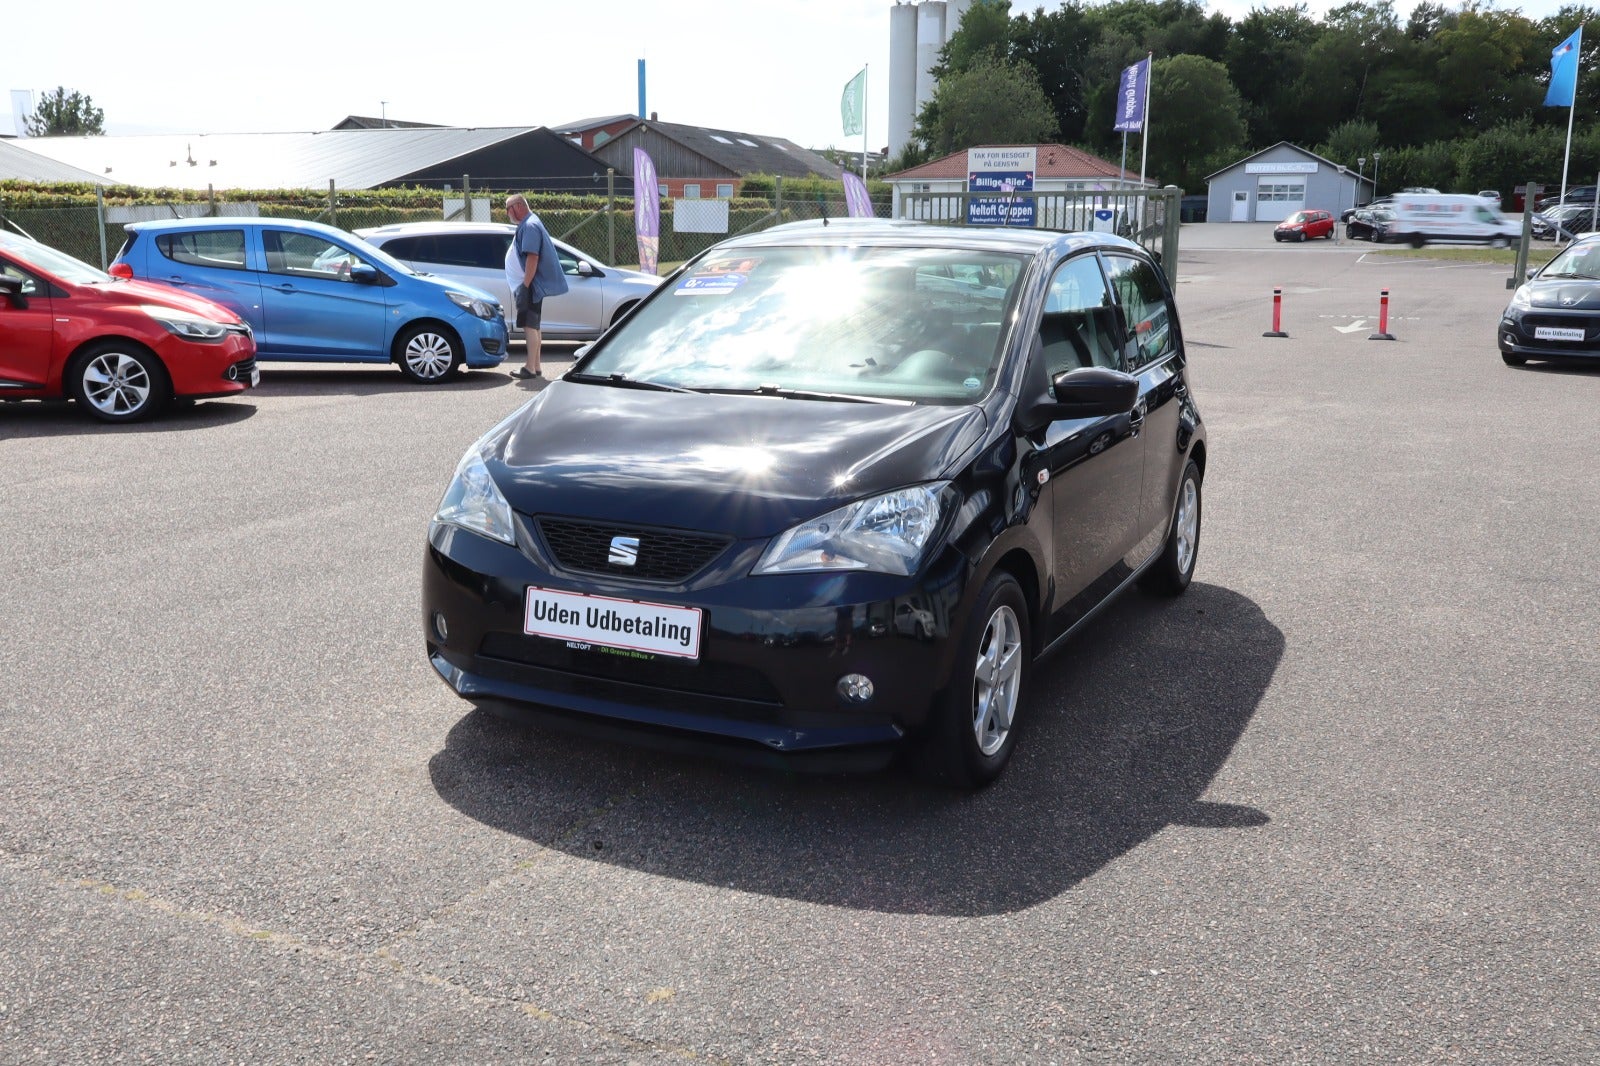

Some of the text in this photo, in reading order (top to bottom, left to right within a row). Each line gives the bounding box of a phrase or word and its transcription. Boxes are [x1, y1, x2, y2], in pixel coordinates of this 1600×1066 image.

[976, 178, 1025, 187] Billige Biler
[970, 204, 997, 215] Neltoft
[1552, 330, 1582, 338] Udbetaling
[534, 599, 691, 647] Uden Udbetaling
[566, 641, 592, 651] NELTOFT
